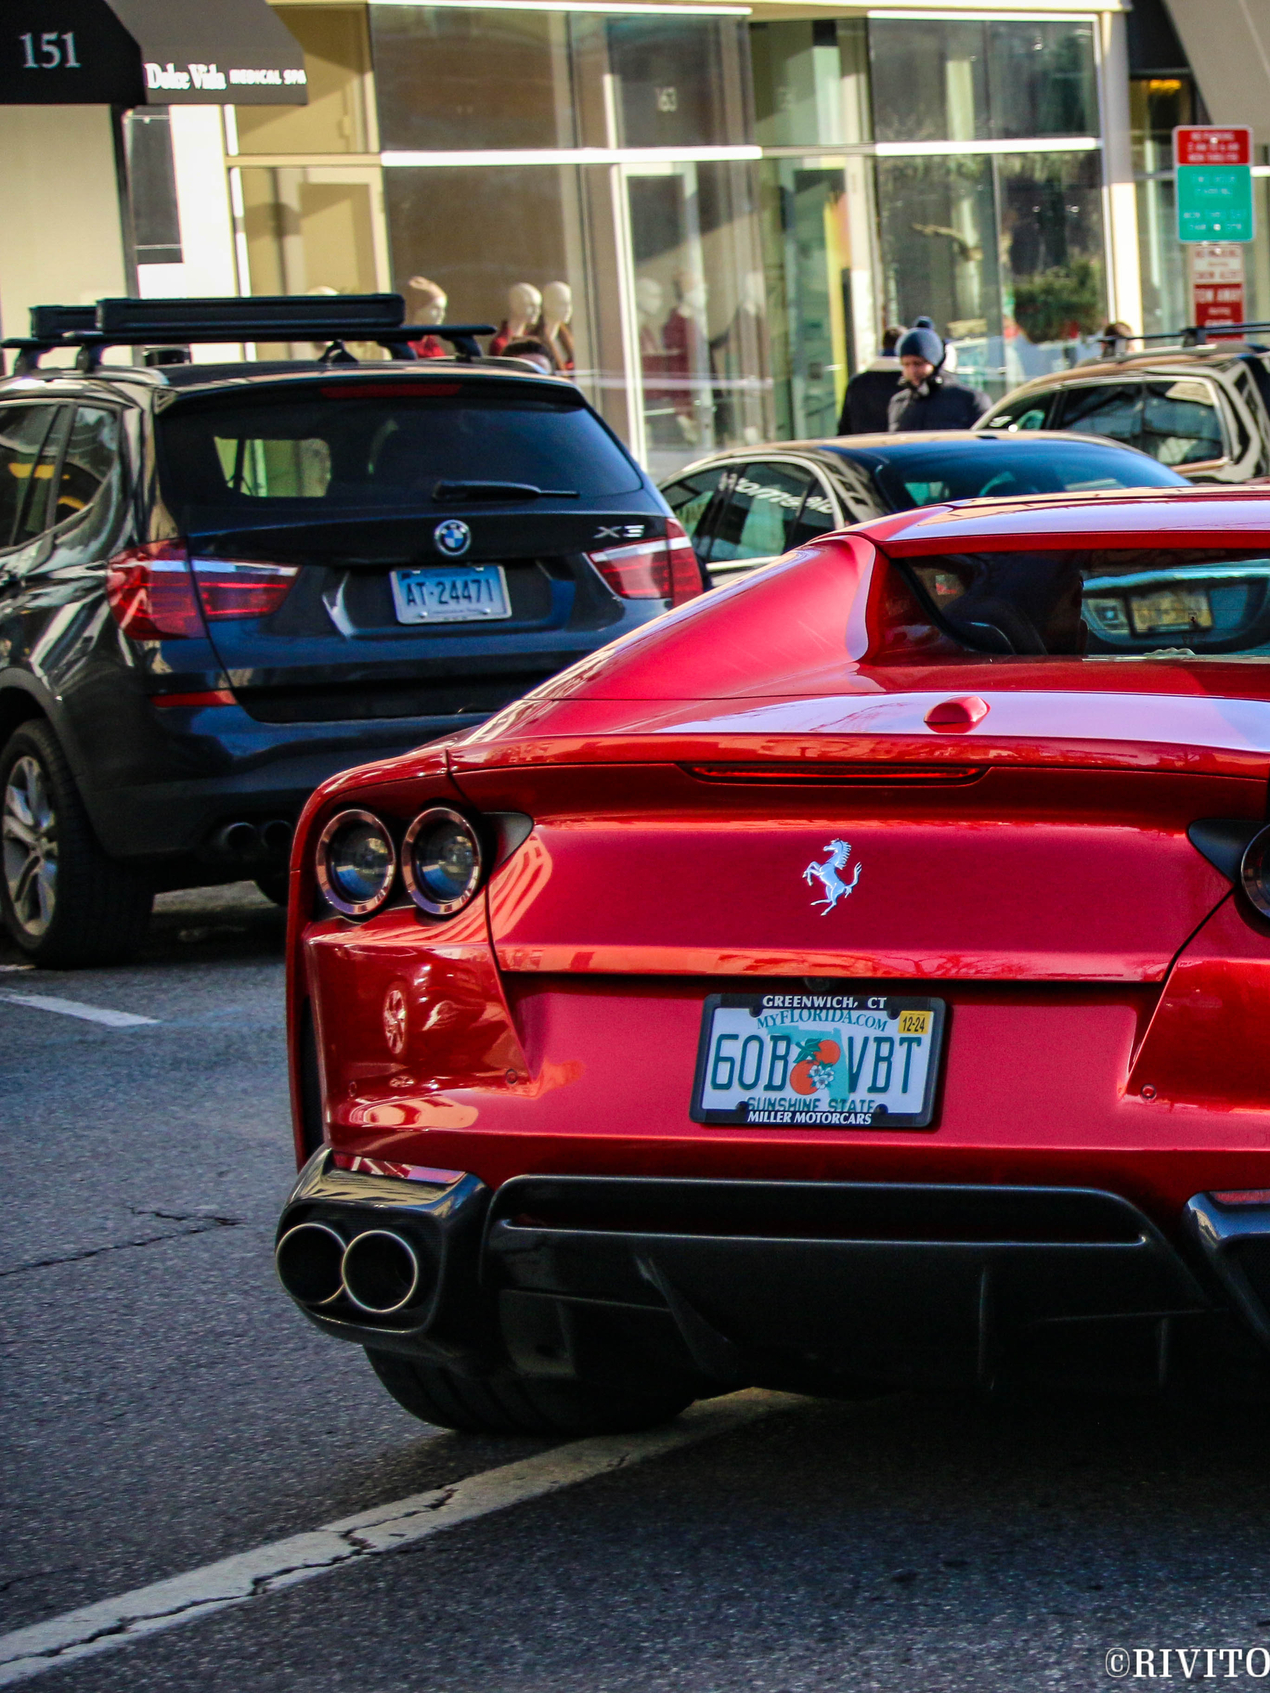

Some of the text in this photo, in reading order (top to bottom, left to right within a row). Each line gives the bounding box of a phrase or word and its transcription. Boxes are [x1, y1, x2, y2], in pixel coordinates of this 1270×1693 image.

[19, 31, 82, 69] 151
[144, 62, 307, 90] Dolce Vida MEDICAL SPA
[593, 524, 645, 539] X3
[762, 995, 887, 1009] GREENWICH, CT
[757, 1009, 888, 1032] MYFLORIDA.COM
[902, 1016, 926, 1032] 12-24
[847, 1036, 922, 1094] VBT
[745, 1096, 876, 1113] SUNSHINE STATE
[747, 1111, 872, 1125] MILLER MOTORCARS
